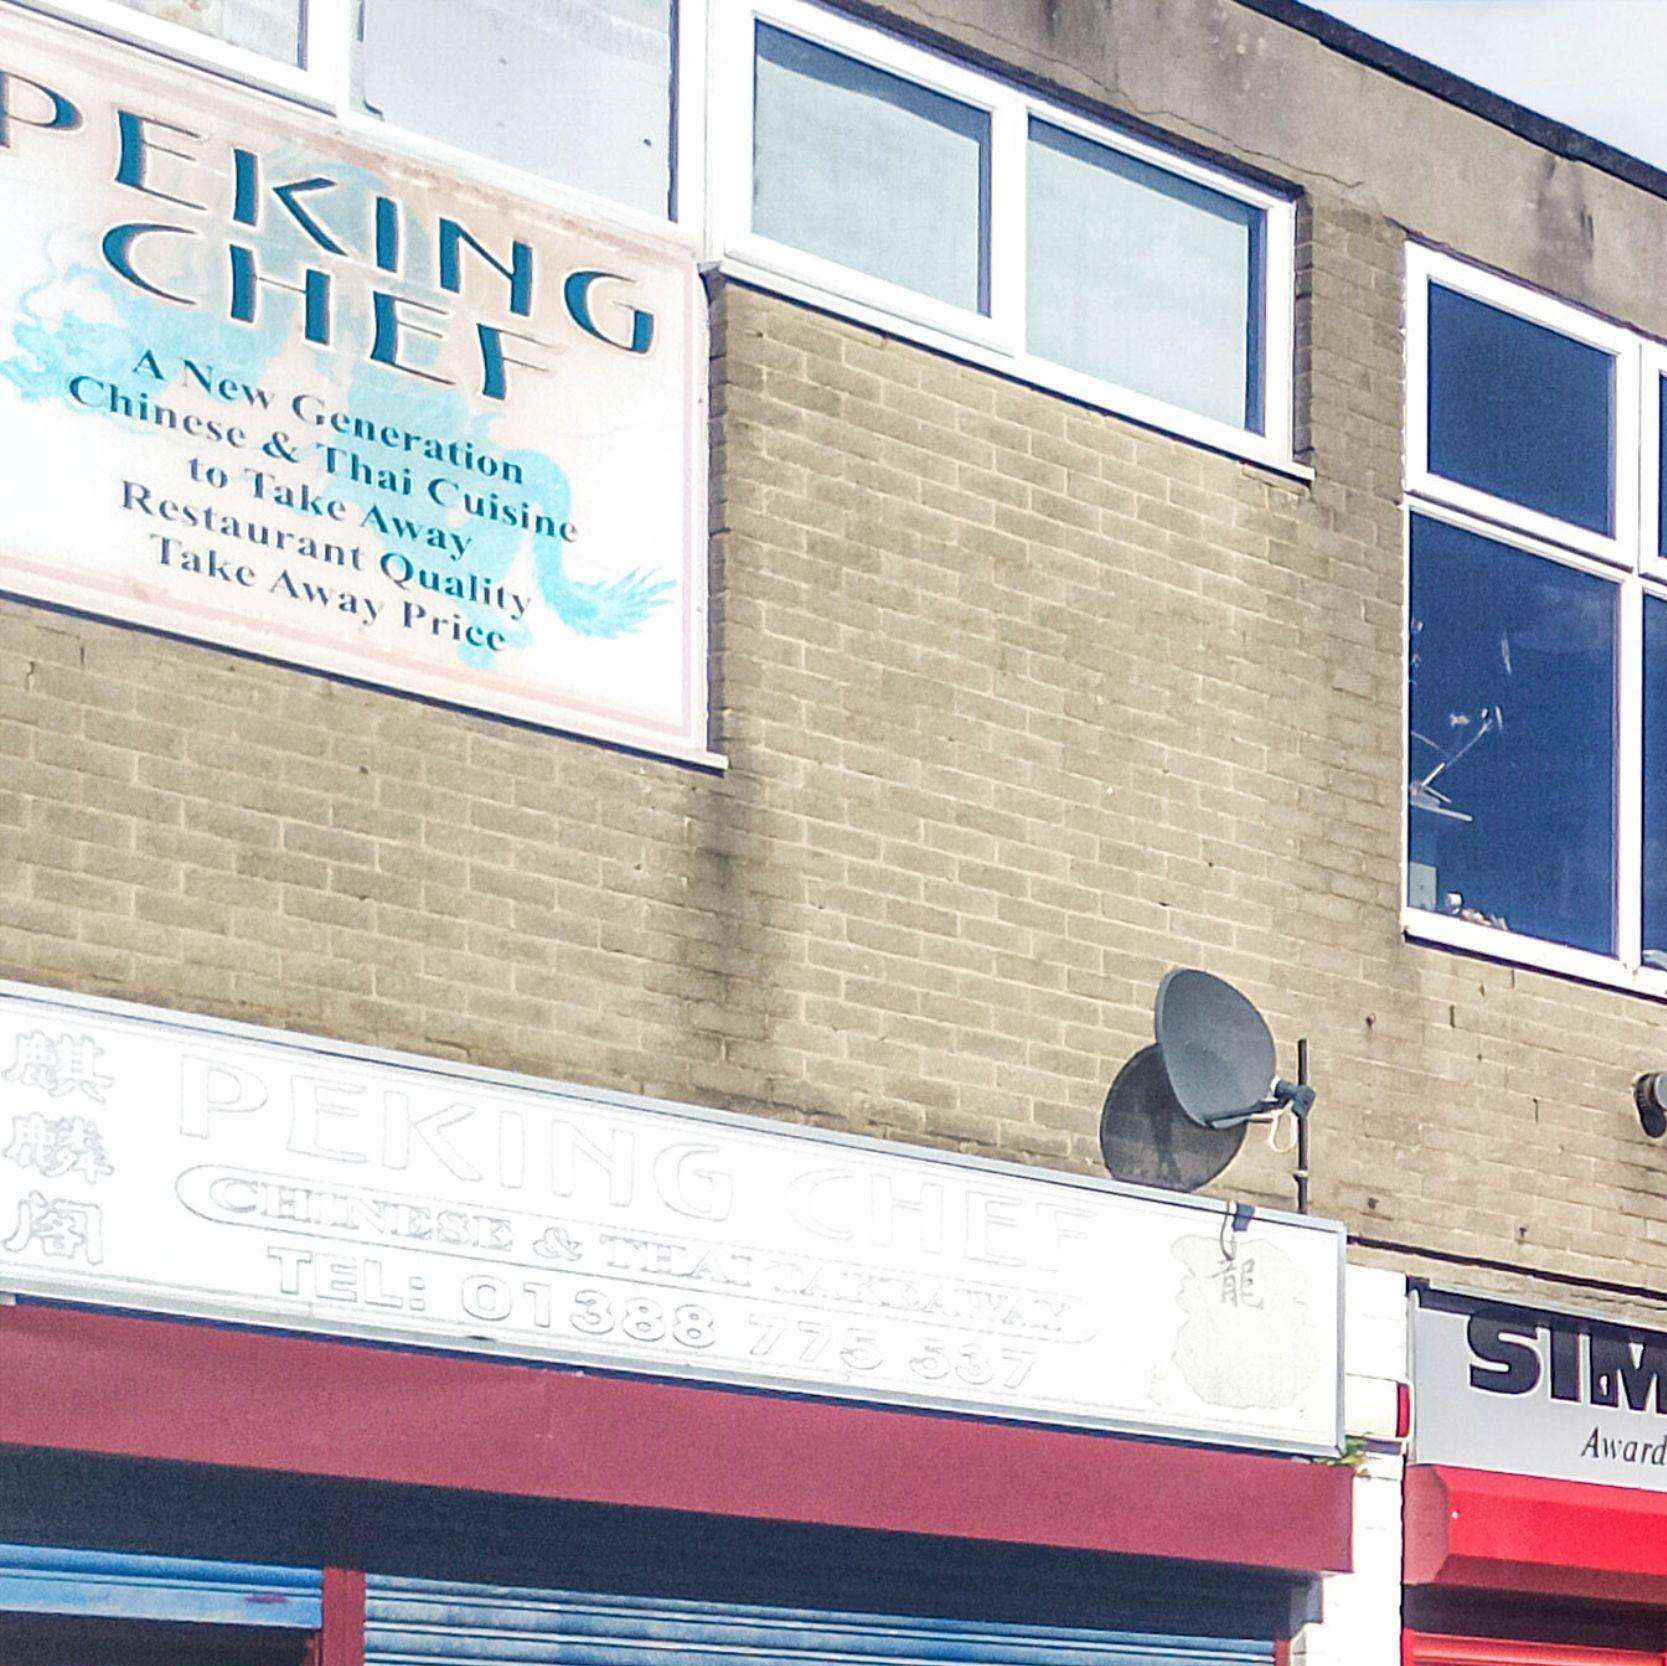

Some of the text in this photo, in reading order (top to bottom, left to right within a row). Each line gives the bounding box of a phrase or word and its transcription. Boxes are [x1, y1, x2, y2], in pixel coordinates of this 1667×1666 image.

[0, 70, 656, 355] PEKING
[101, 222, 556, 401] CHEF
[68, 373, 580, 544] Chinese & Thai Cuisine
[132, 349, 524, 486] A New Generation
[120, 479, 533, 622] Restaurant Quality
[187, 457, 475, 560] to Take Away
[150, 533, 508, 652] Take Away Price
[179, 1053, 1099, 1274] PEKING CHEF
[209, 1176, 515, 1252] CHINESE
[532, 1225, 584, 1262] &
[266, 1245, 426, 1312] TEL:
[461, 1272, 719, 1350] 01388
[1580, 1433, 1667, 1468] Award
